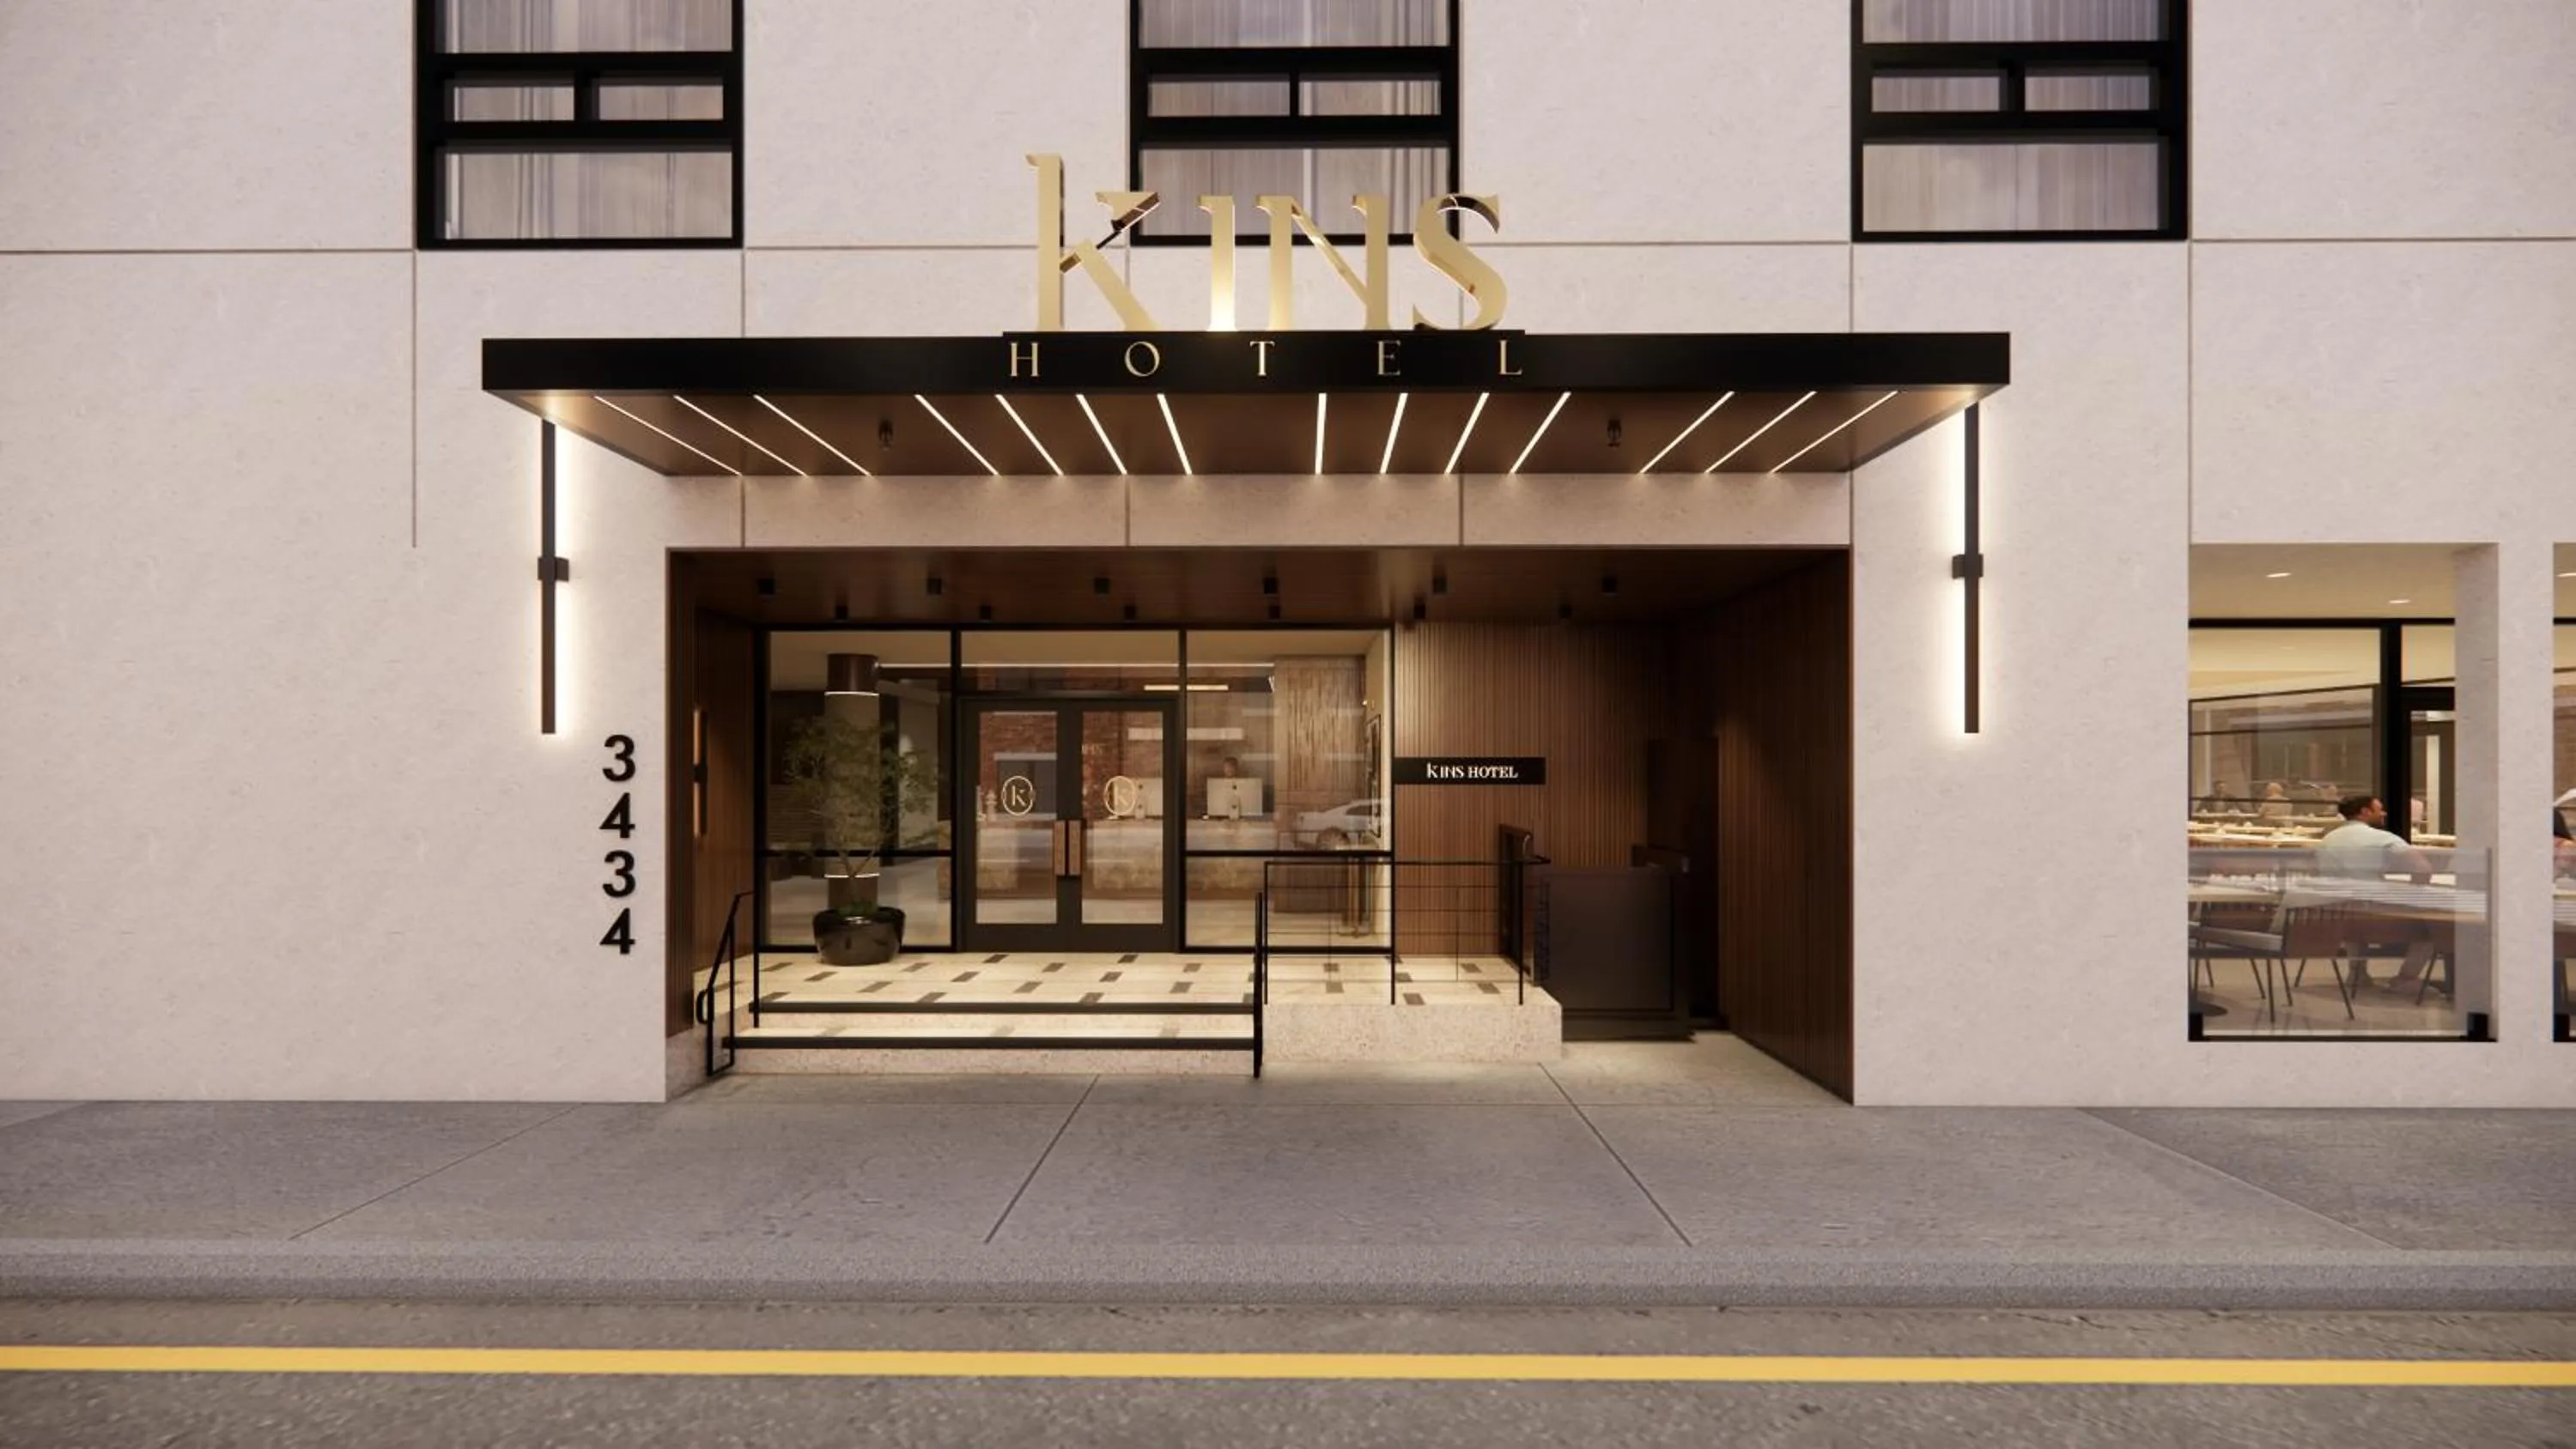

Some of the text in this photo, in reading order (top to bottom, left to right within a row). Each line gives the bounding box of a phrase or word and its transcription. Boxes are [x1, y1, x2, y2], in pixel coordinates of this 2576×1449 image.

[1025, 154, 1507, 331] KINS
[1009, 340, 1523, 379] HOTEL
[1426, 761, 1519, 779] KINS HOTEL
[598, 734, 636, 955] 3434
